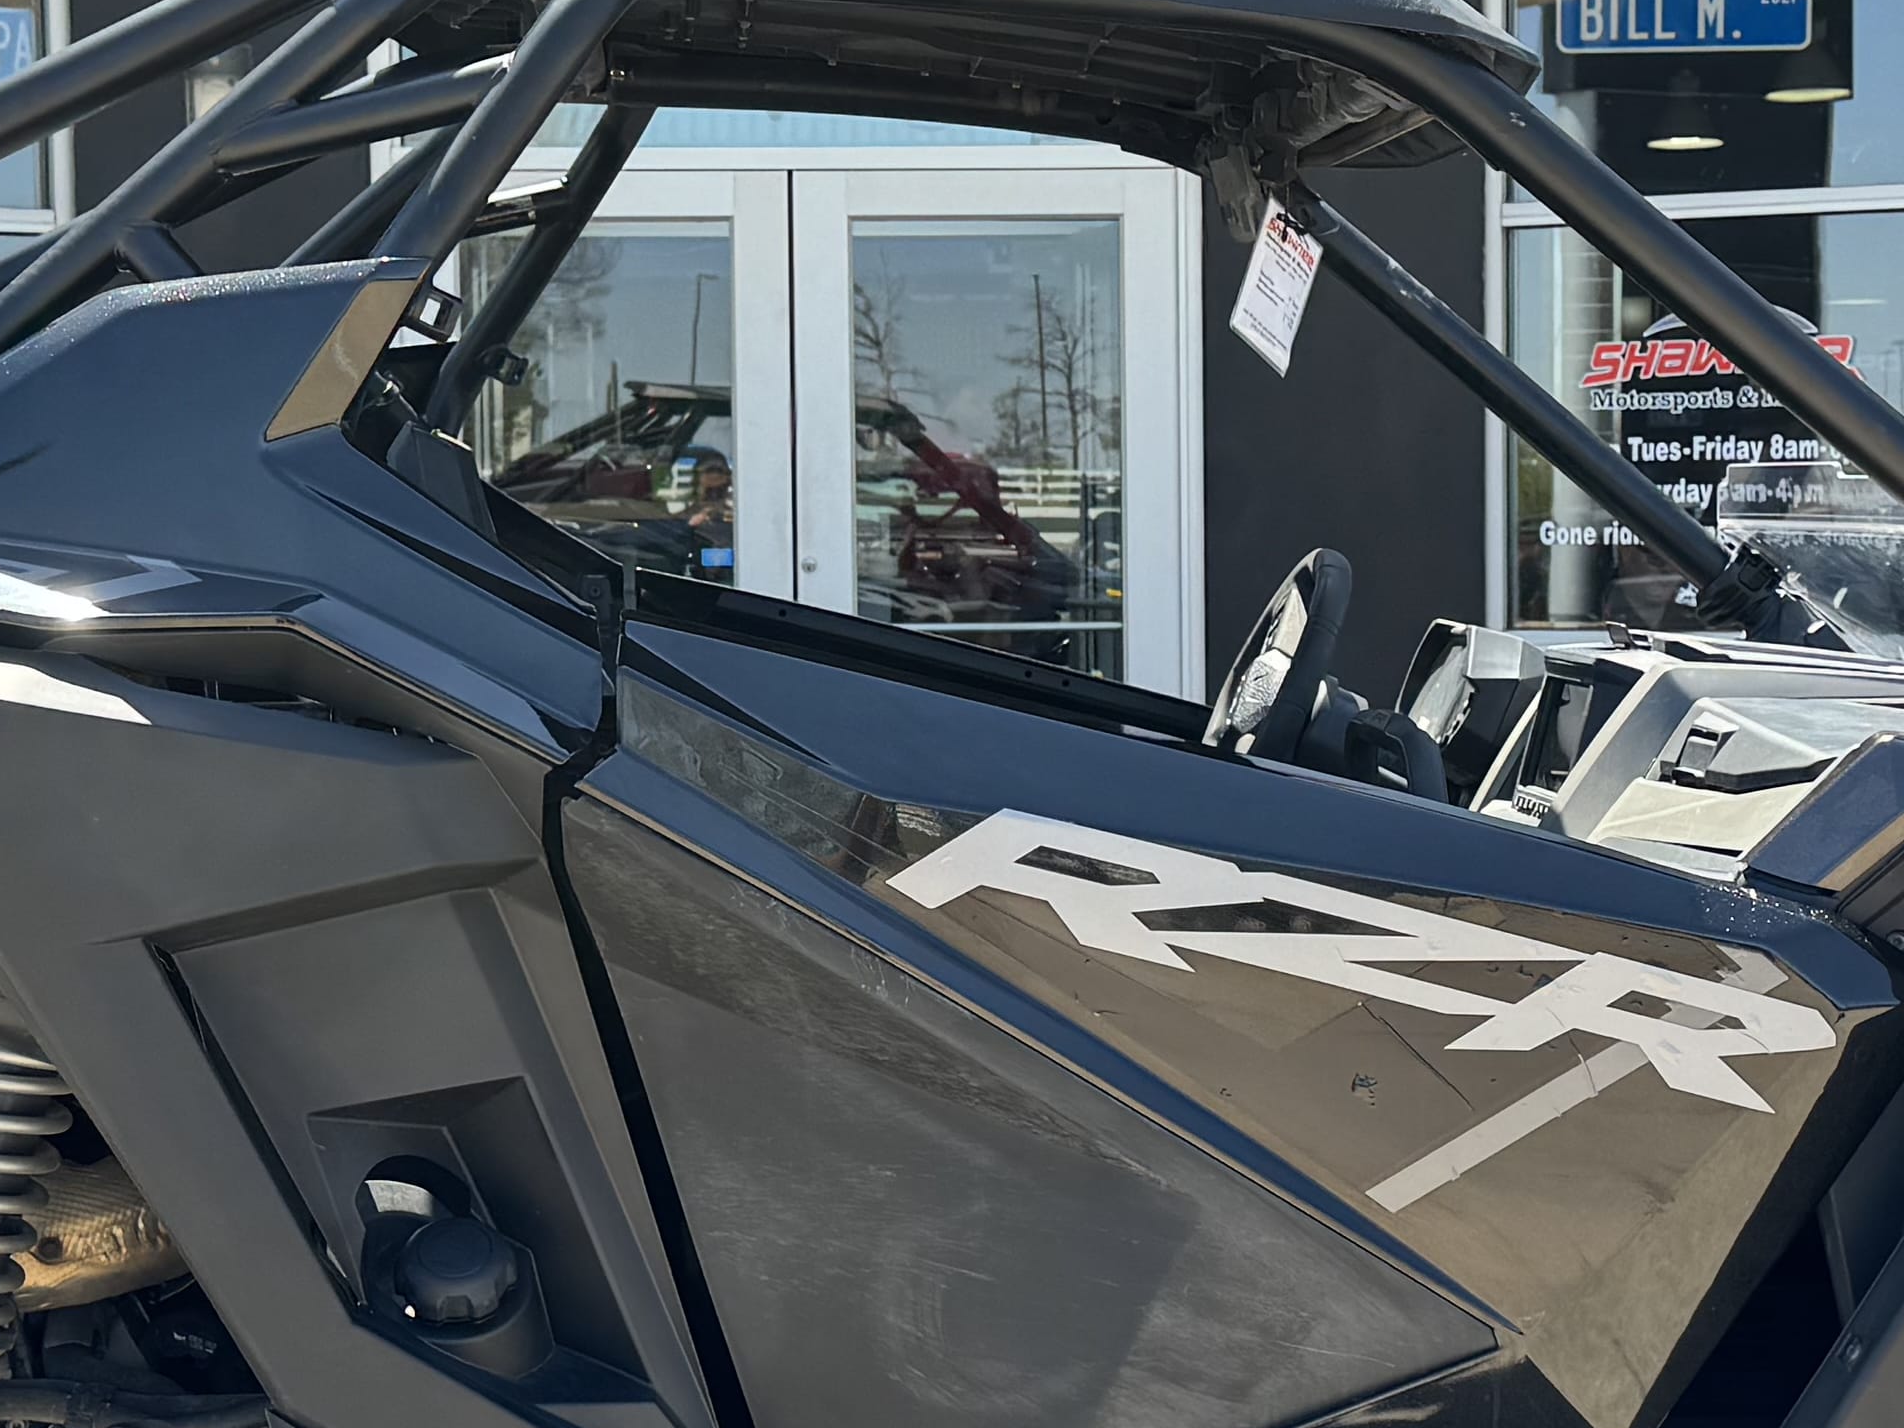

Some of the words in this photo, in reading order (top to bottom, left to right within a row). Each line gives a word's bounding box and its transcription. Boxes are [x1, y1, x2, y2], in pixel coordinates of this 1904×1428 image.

[1591, 387, 1733, 414] Motorsports
[1736, 386, 1758, 408] &
[1539, 521, 1595, 547] Gone
[885, 808, 1837, 1115] RZR
